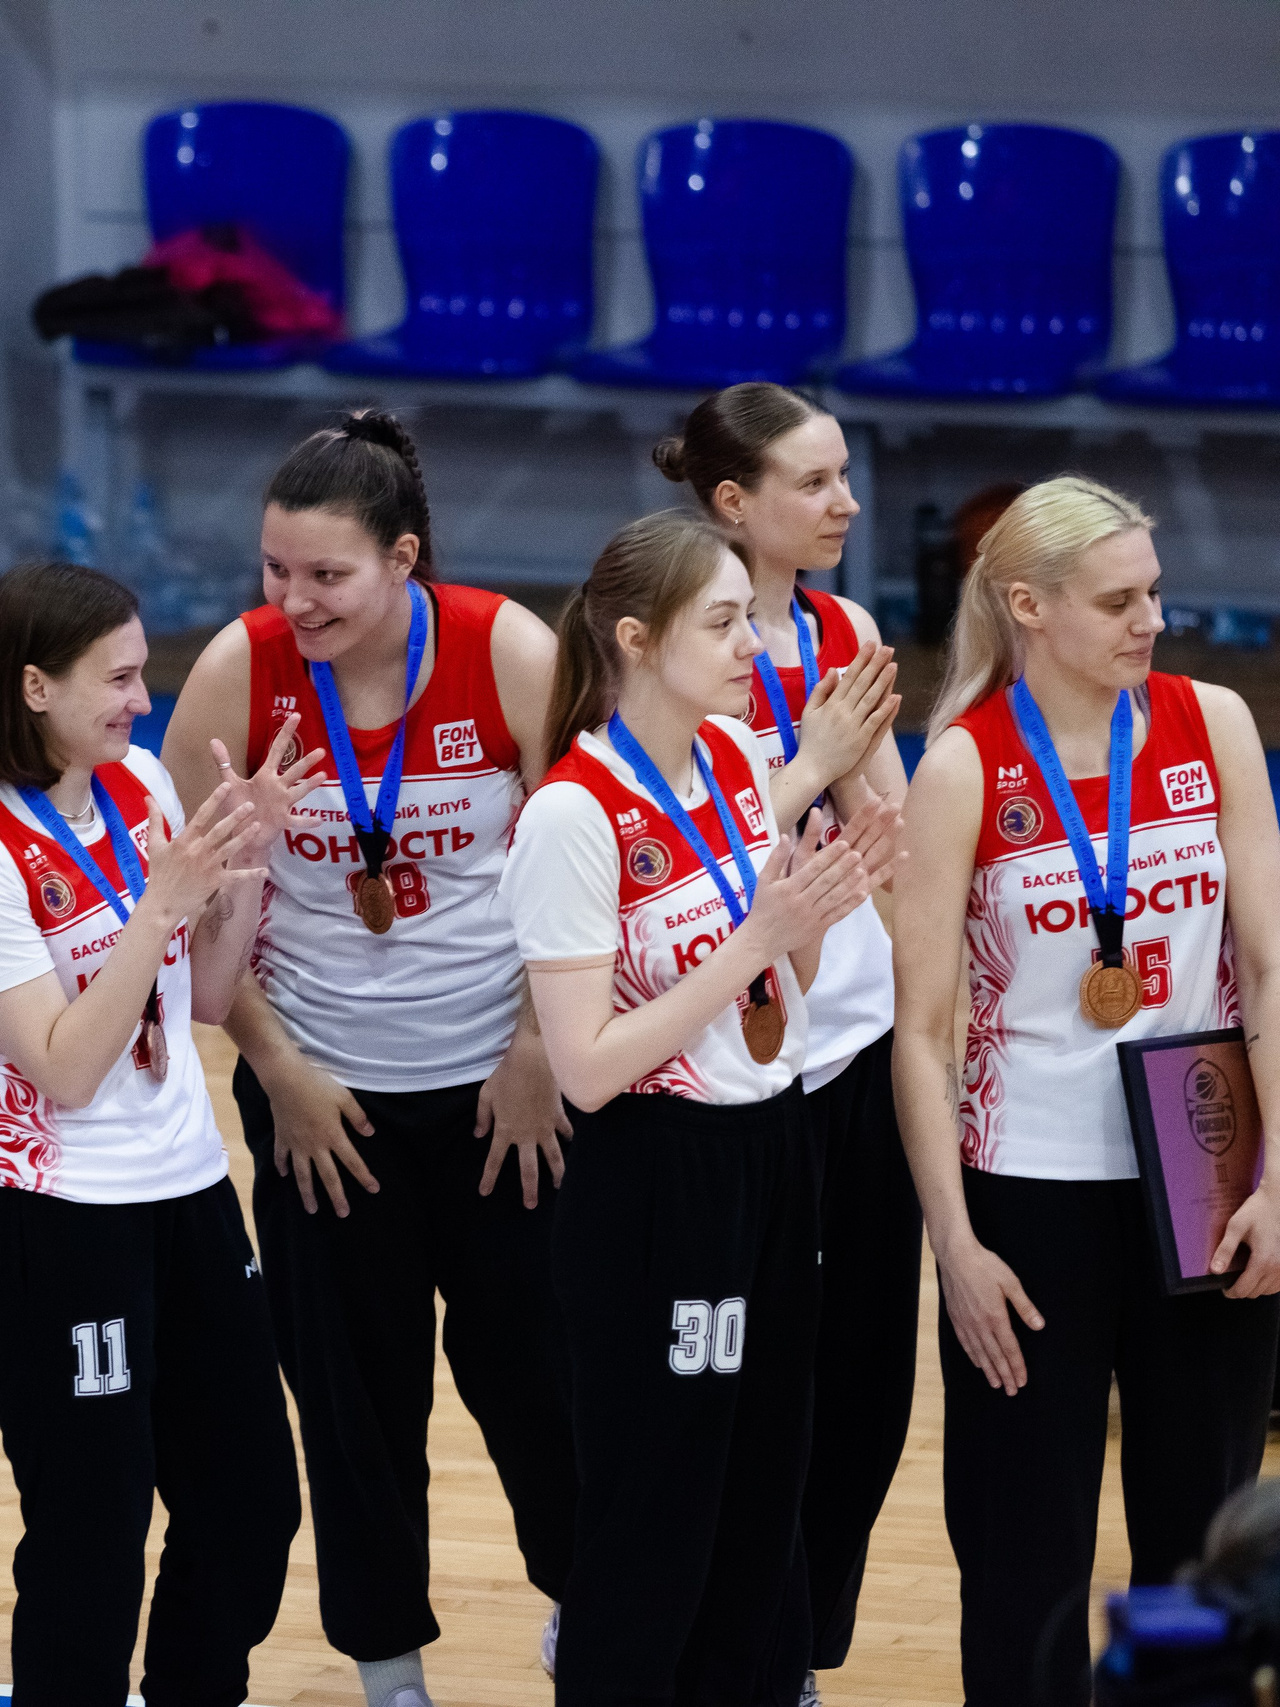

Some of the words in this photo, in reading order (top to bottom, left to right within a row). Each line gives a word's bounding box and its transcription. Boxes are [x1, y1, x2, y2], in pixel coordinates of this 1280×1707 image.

[438, 724, 474, 746] FON
[440, 740, 478, 763] BET
[998, 764, 1022, 780] N1
[1166, 766, 1202, 788] FON
[996, 777, 1028, 790] SPORT
[1171, 782, 1207, 805] BET
[428, 798, 471, 816] КЛУБ
[30, 855, 48, 869] ORT
[1174, 840, 1216, 862] КЛУБ
[345, 861, 431, 919] 8
[71, 929, 123, 960] БАСКЕТ
[1091, 935, 1172, 1010] 5
[668, 1296, 746, 1374] 30
[72, 1318, 131, 1396] 11
